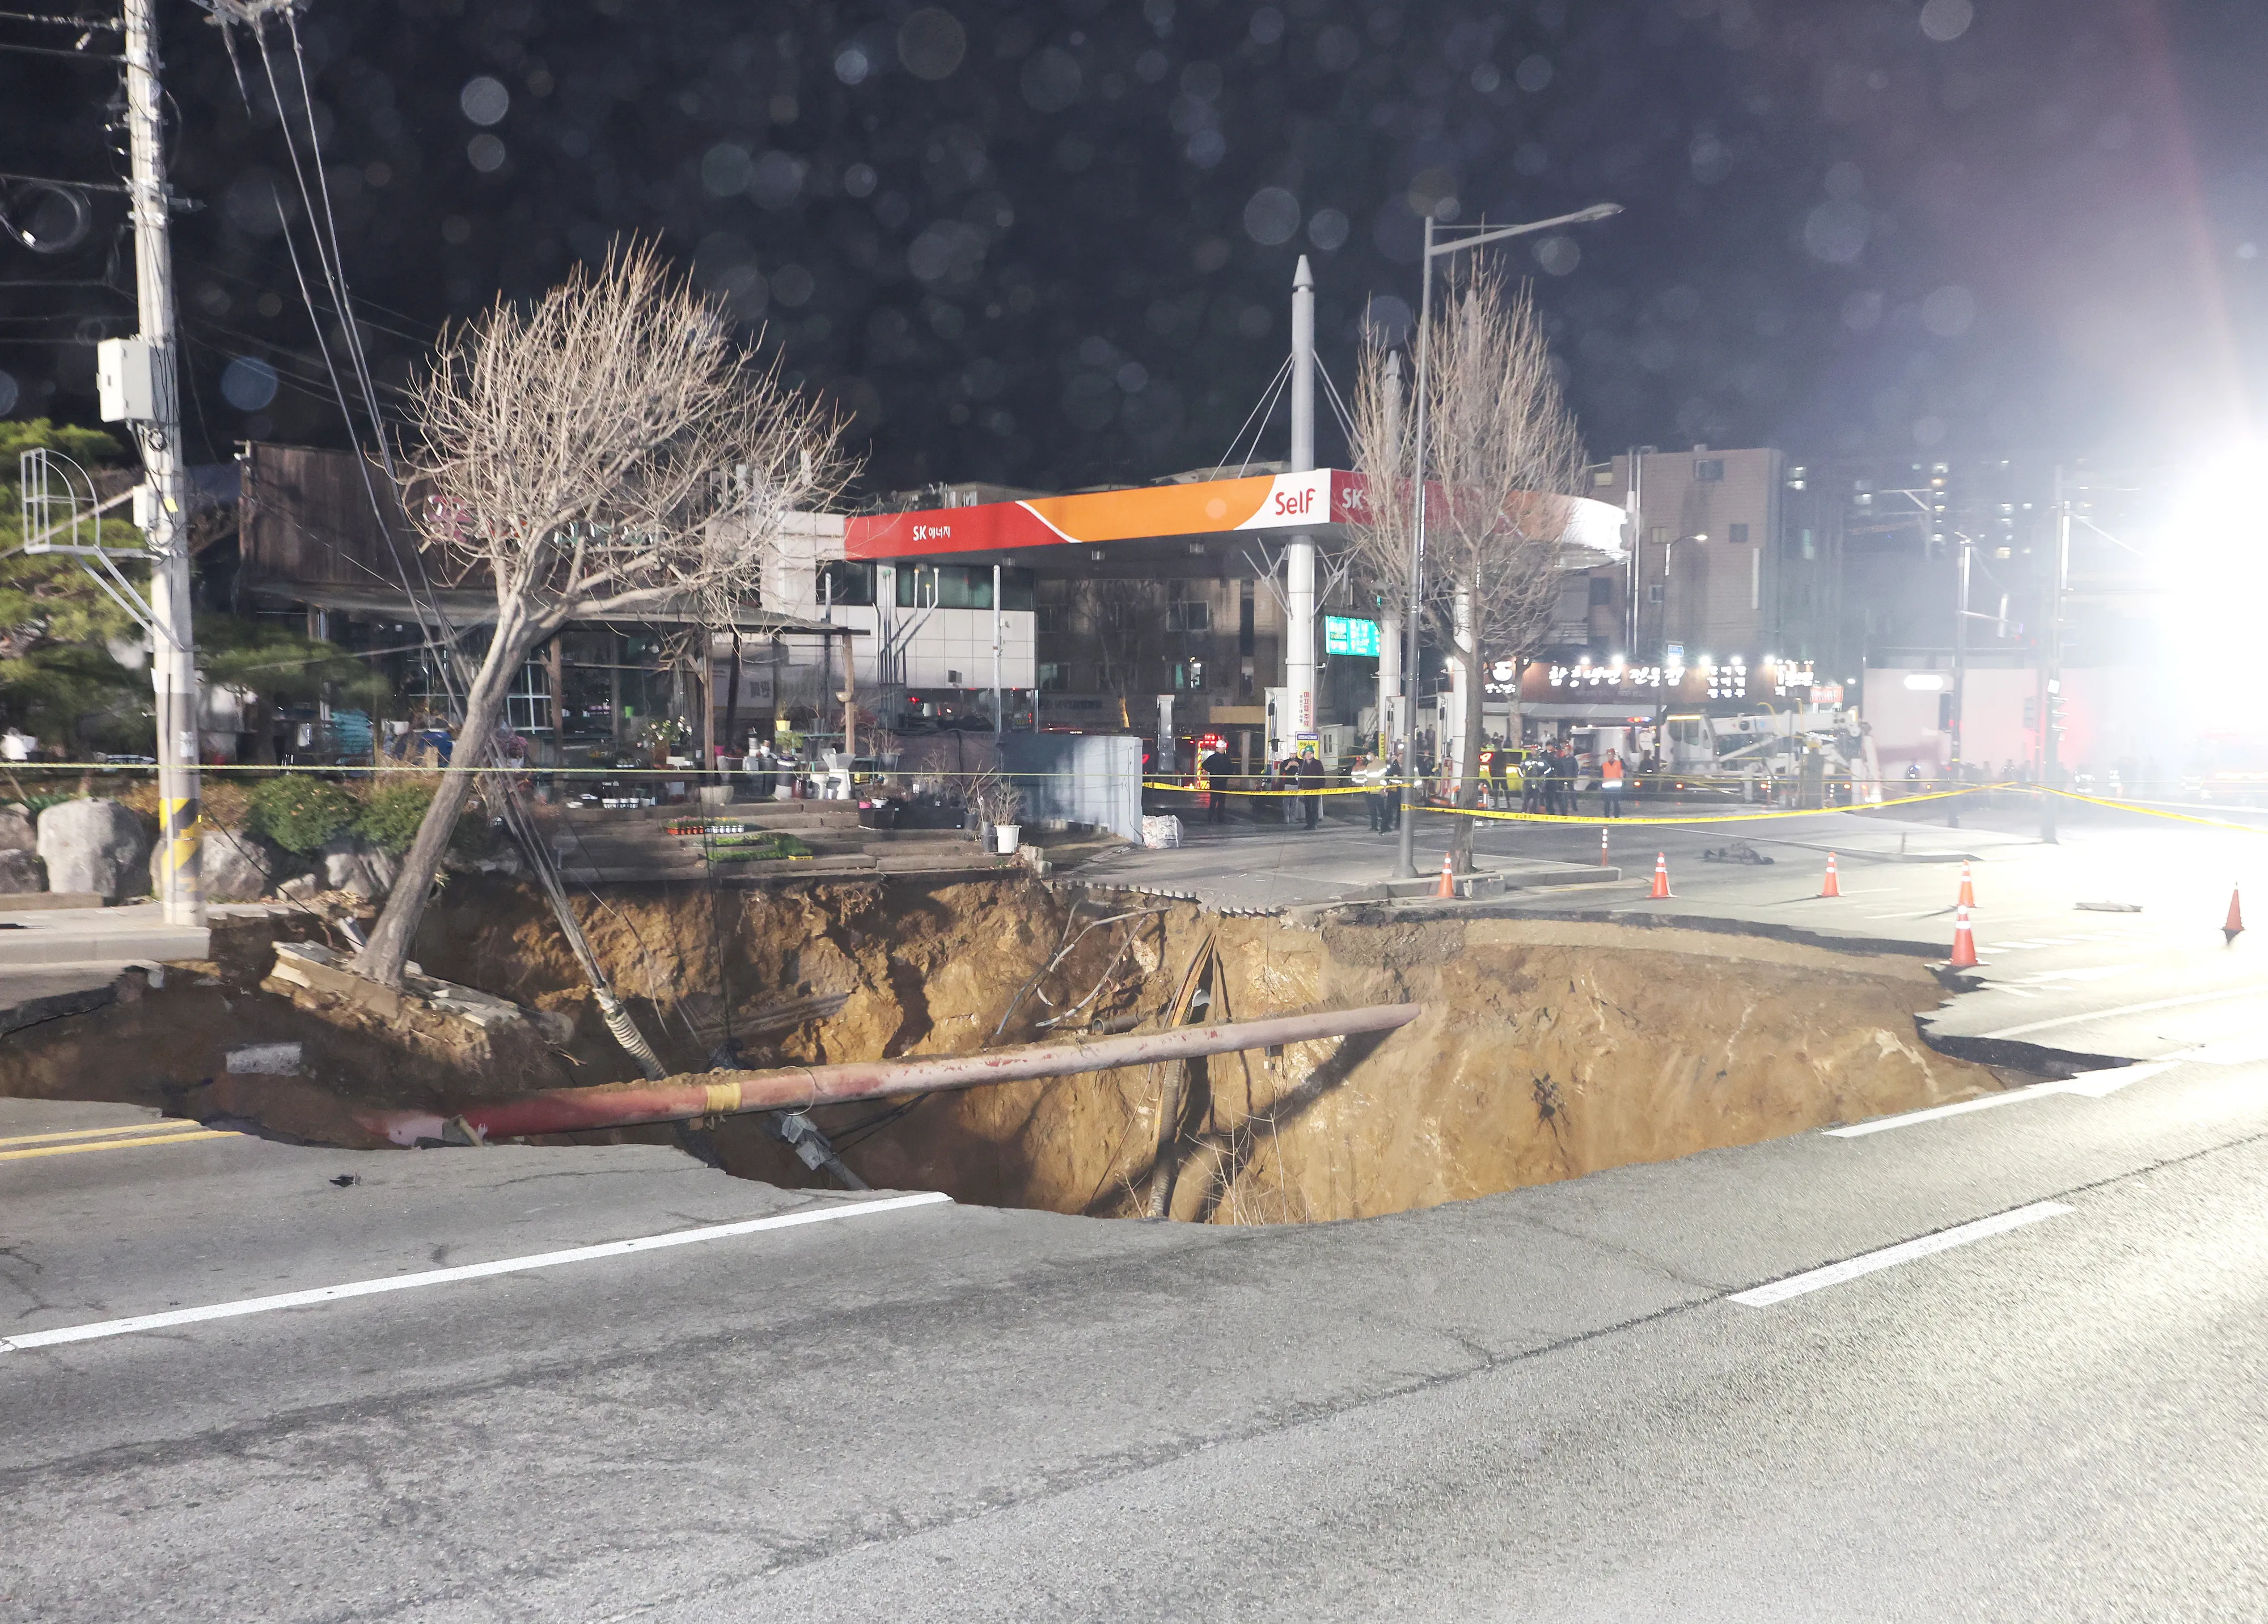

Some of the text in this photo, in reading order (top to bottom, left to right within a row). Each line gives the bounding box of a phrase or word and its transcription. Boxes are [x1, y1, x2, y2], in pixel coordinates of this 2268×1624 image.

[1275, 488, 1316, 515] Self
[1342, 487, 1364, 510] SK
[913, 524, 950, 541] SK 에너지
[1548, 665, 1686, 688] 함흥냉면 전문점
